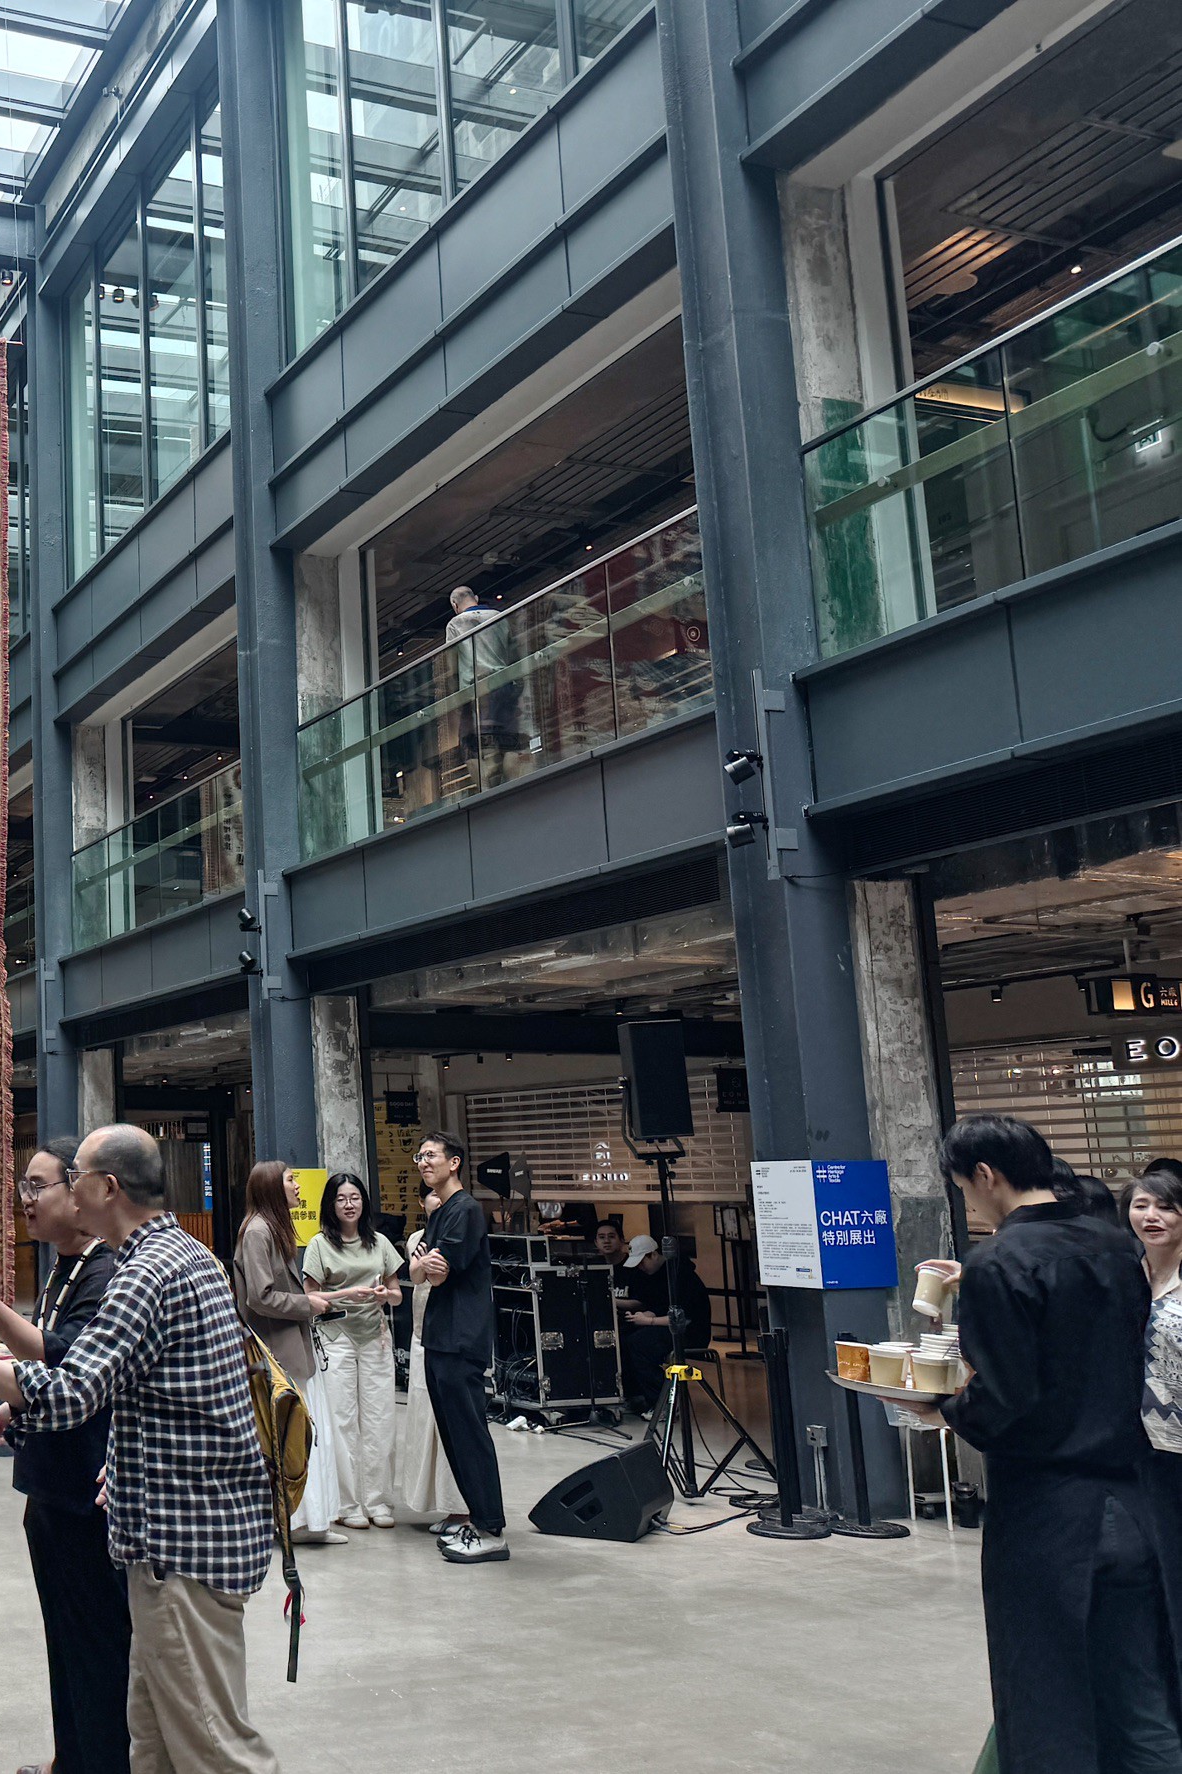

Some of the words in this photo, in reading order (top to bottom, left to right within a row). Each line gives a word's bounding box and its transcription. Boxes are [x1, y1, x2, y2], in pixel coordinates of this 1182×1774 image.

[1140, 982, 1155, 1008] G
[822, 1229, 876, 1246] 特別展出
